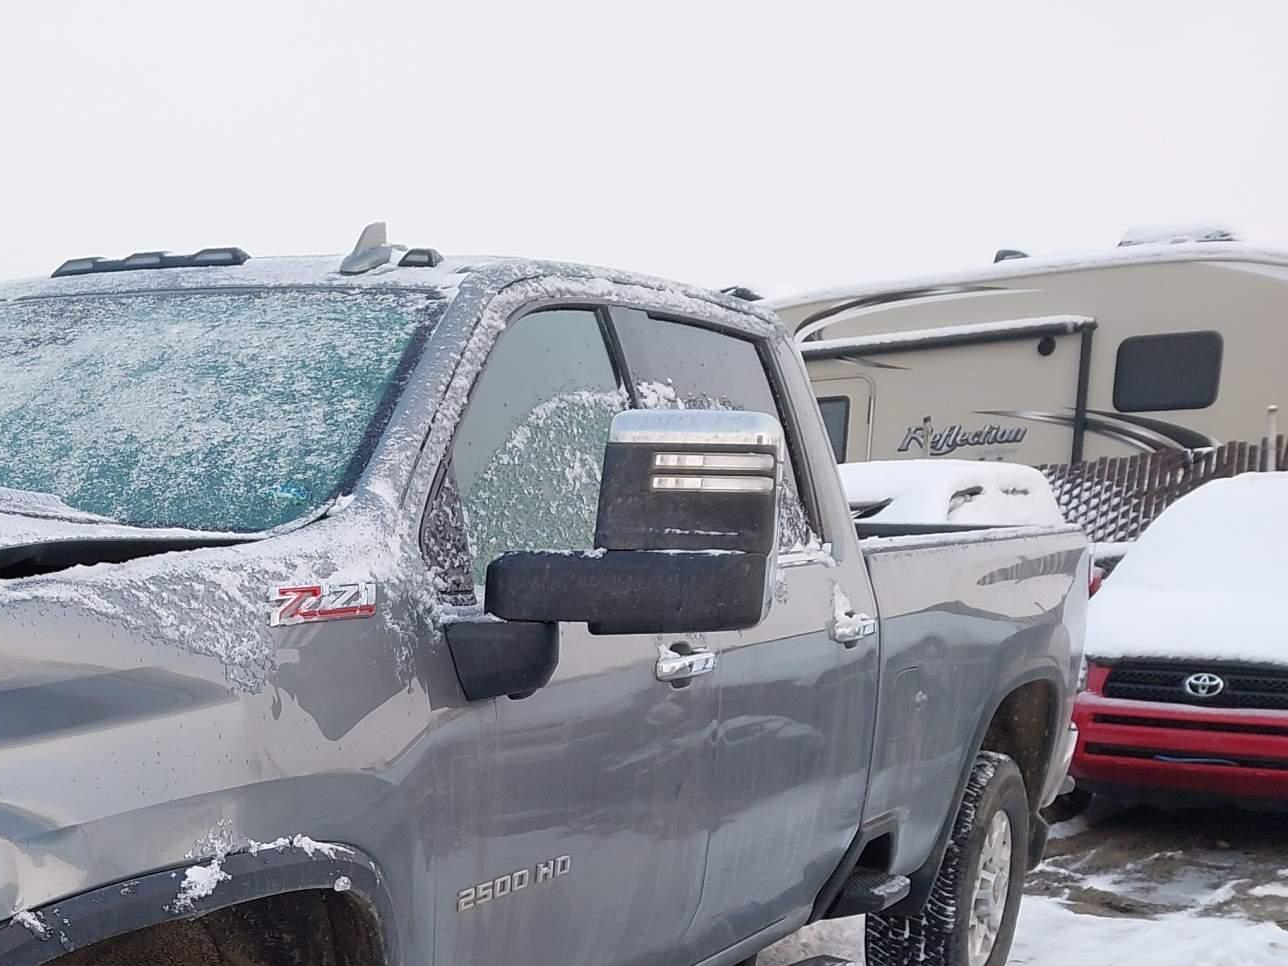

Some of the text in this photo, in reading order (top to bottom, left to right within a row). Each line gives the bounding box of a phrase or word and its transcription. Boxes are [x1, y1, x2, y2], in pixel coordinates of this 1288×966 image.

[897, 424, 1027, 456] Reflection
[457, 855, 571, 912] 2500 HD
